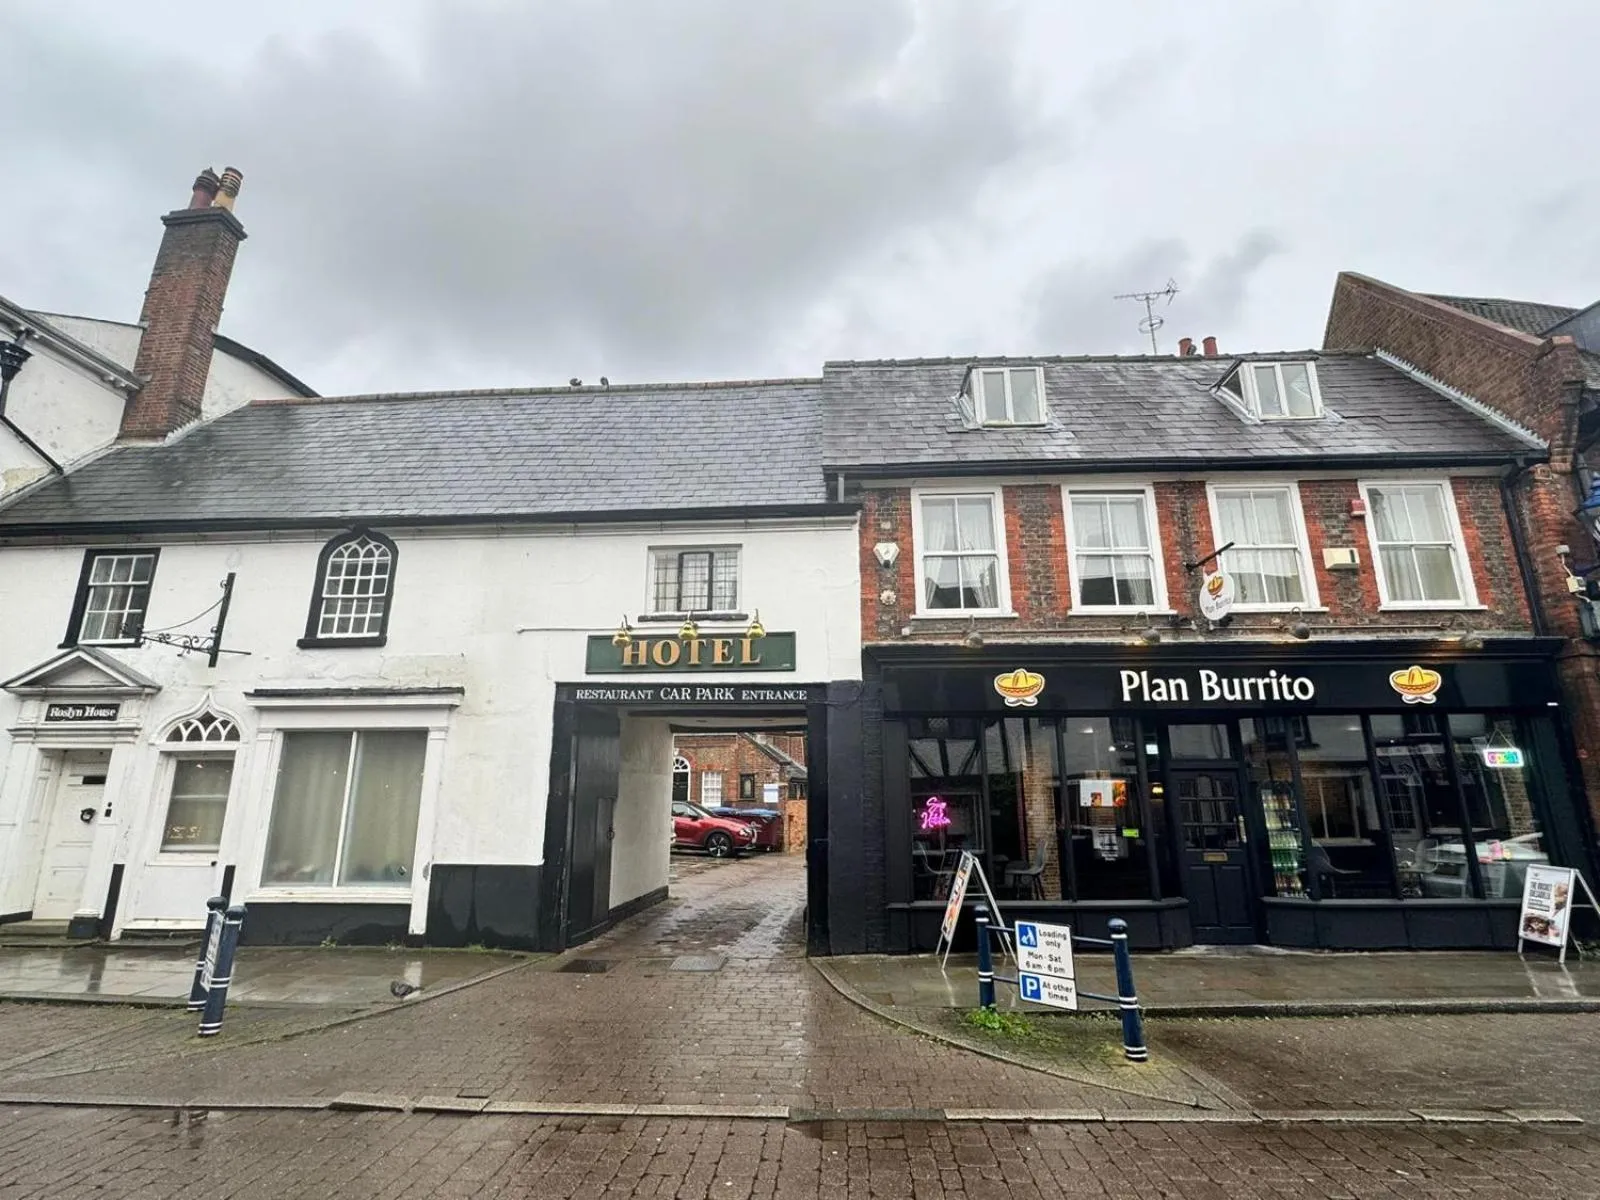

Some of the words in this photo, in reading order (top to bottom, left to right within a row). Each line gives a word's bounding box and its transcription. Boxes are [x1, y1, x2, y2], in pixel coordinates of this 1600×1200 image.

[621, 638, 762, 666] HOTEL
[1120, 670, 1189, 702] Plan
[1198, 669, 1315, 701] Burrito
[575, 689, 655, 700] RESTAURANT
[660, 687, 691, 701] CAR
[695, 686, 735, 700] PARK
[741, 689, 808, 700] ENTRANCE
[50, 707, 83, 719] Roslyn
[84, 705, 116, 717] House
[1038, 929, 1067, 940] Loading
[1045, 940, 1061, 949] only
[1028, 951, 1043, 960] Mon
[1048, 954, 1062, 963] Sat
[1042, 981, 1051, 990] At
[1053, 984, 1073, 993] other
[1048, 992, 1069, 1002] times
